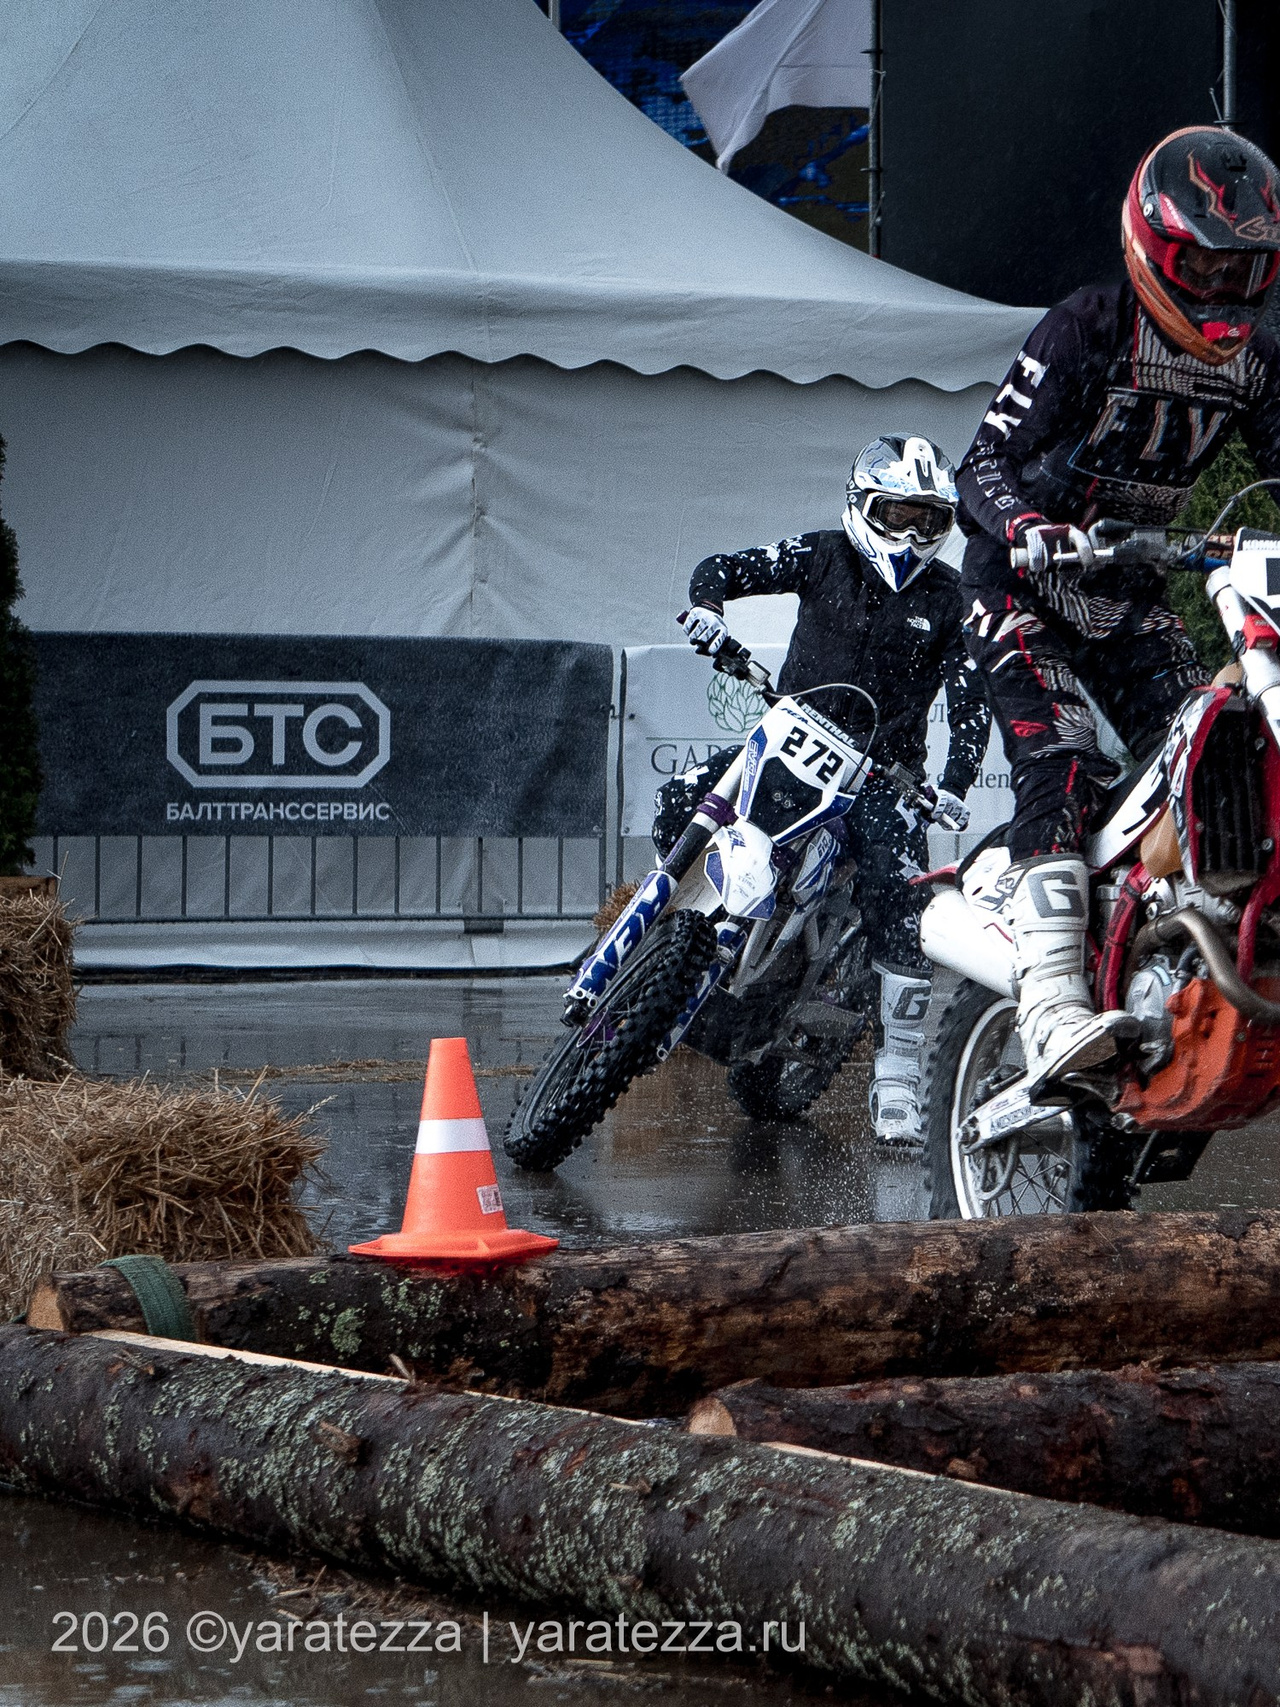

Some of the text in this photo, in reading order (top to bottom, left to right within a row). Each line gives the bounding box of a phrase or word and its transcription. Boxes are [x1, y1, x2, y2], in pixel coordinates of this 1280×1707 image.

[199, 703, 363, 766] БТС
[800, 702, 858, 749] RENTHAL
[780, 726, 845, 785] 272
[166, 801, 391, 821] БАЛТТРАНССЕРВИС
